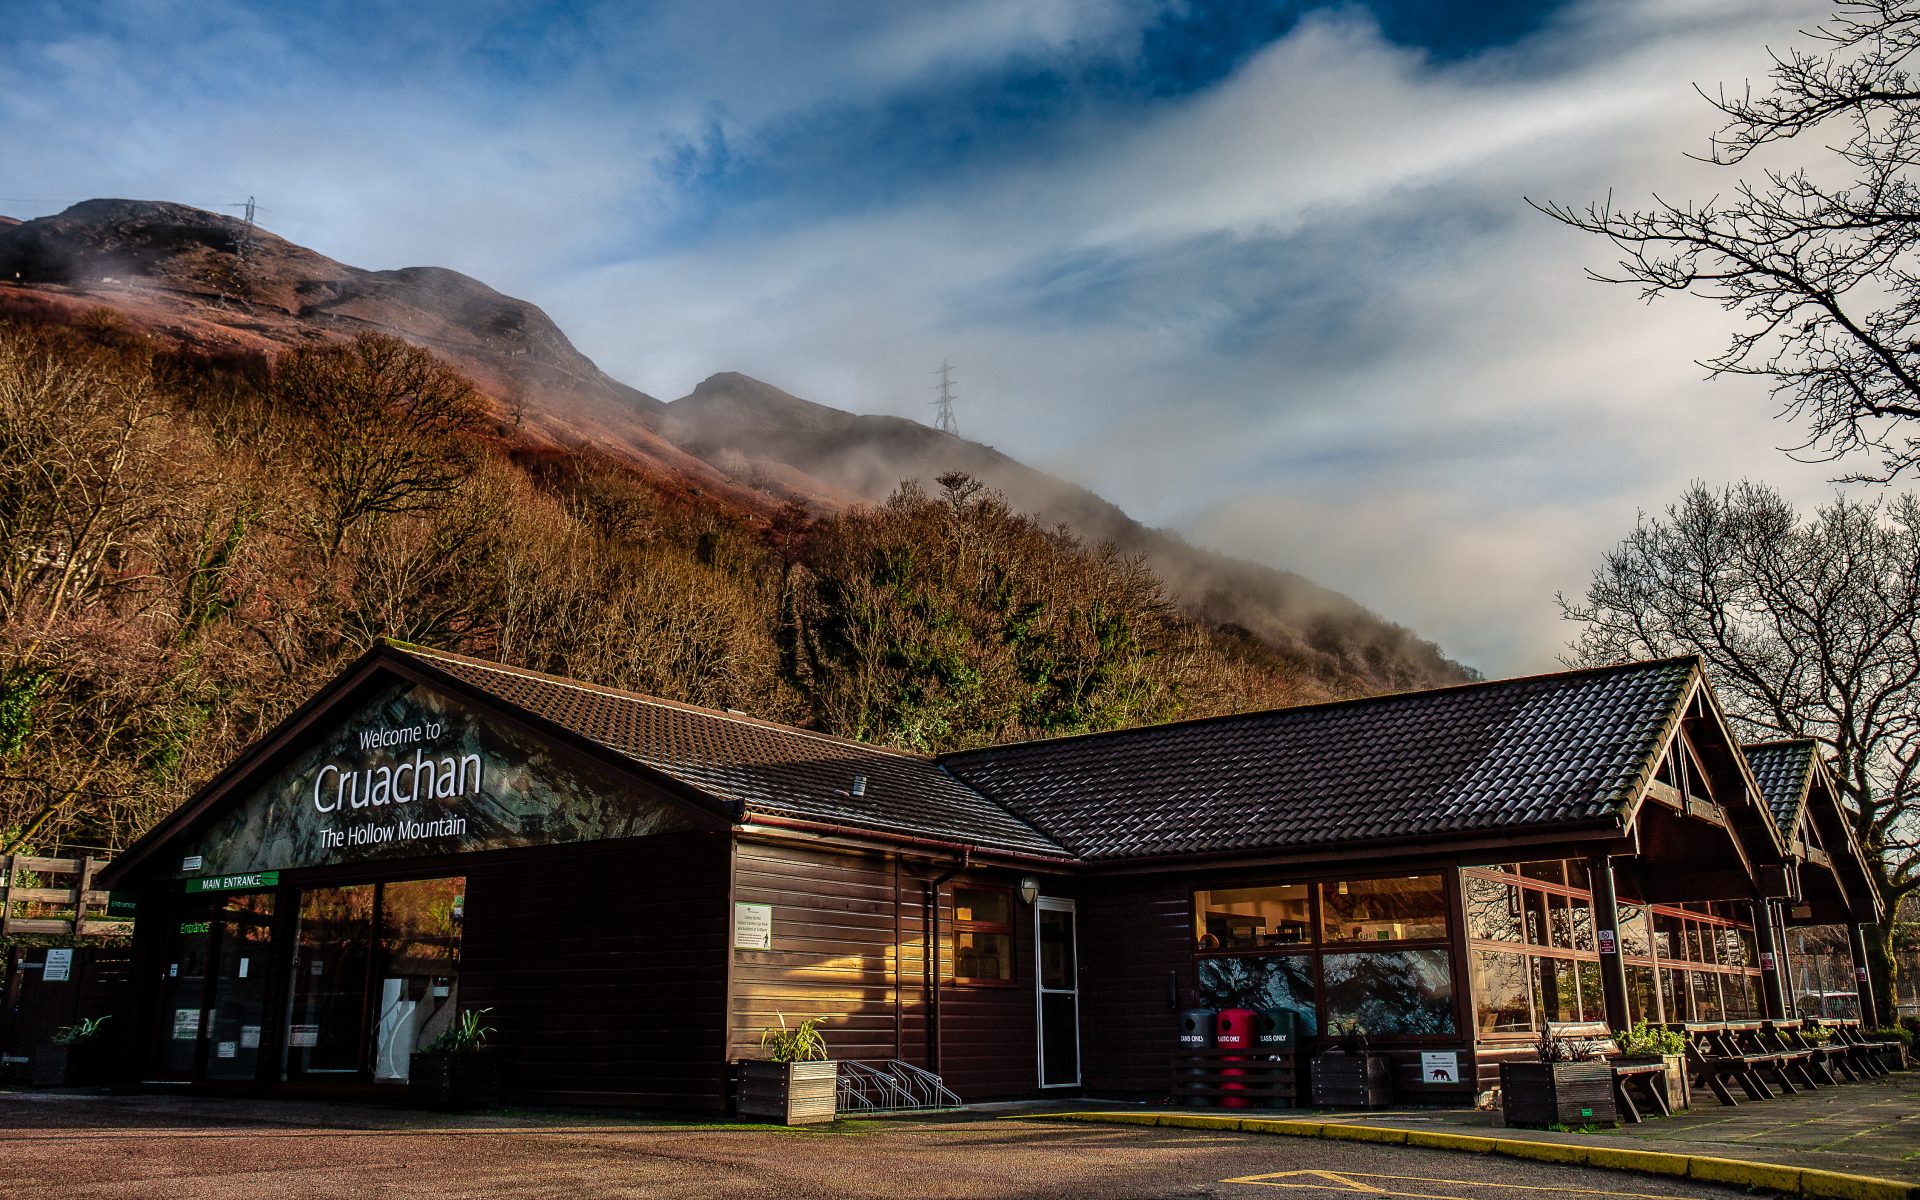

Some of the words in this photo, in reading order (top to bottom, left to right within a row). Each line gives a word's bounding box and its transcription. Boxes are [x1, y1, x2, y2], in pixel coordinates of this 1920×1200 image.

[360, 726, 422, 750] Welcome
[426, 721, 441, 740] to
[314, 749, 482, 813] Cruachan
[320, 827, 344, 849] The
[347, 822, 395, 846] Hollow
[398, 814, 466, 841] Mountain
[202, 879, 221, 890] MAIN
[223, 874, 262, 888] ENTRANCE
[181, 922, 210, 934] Entrance
[1230, 1035, 1240, 1043] ONLY
[1273, 1034, 1287, 1042] ONLY
